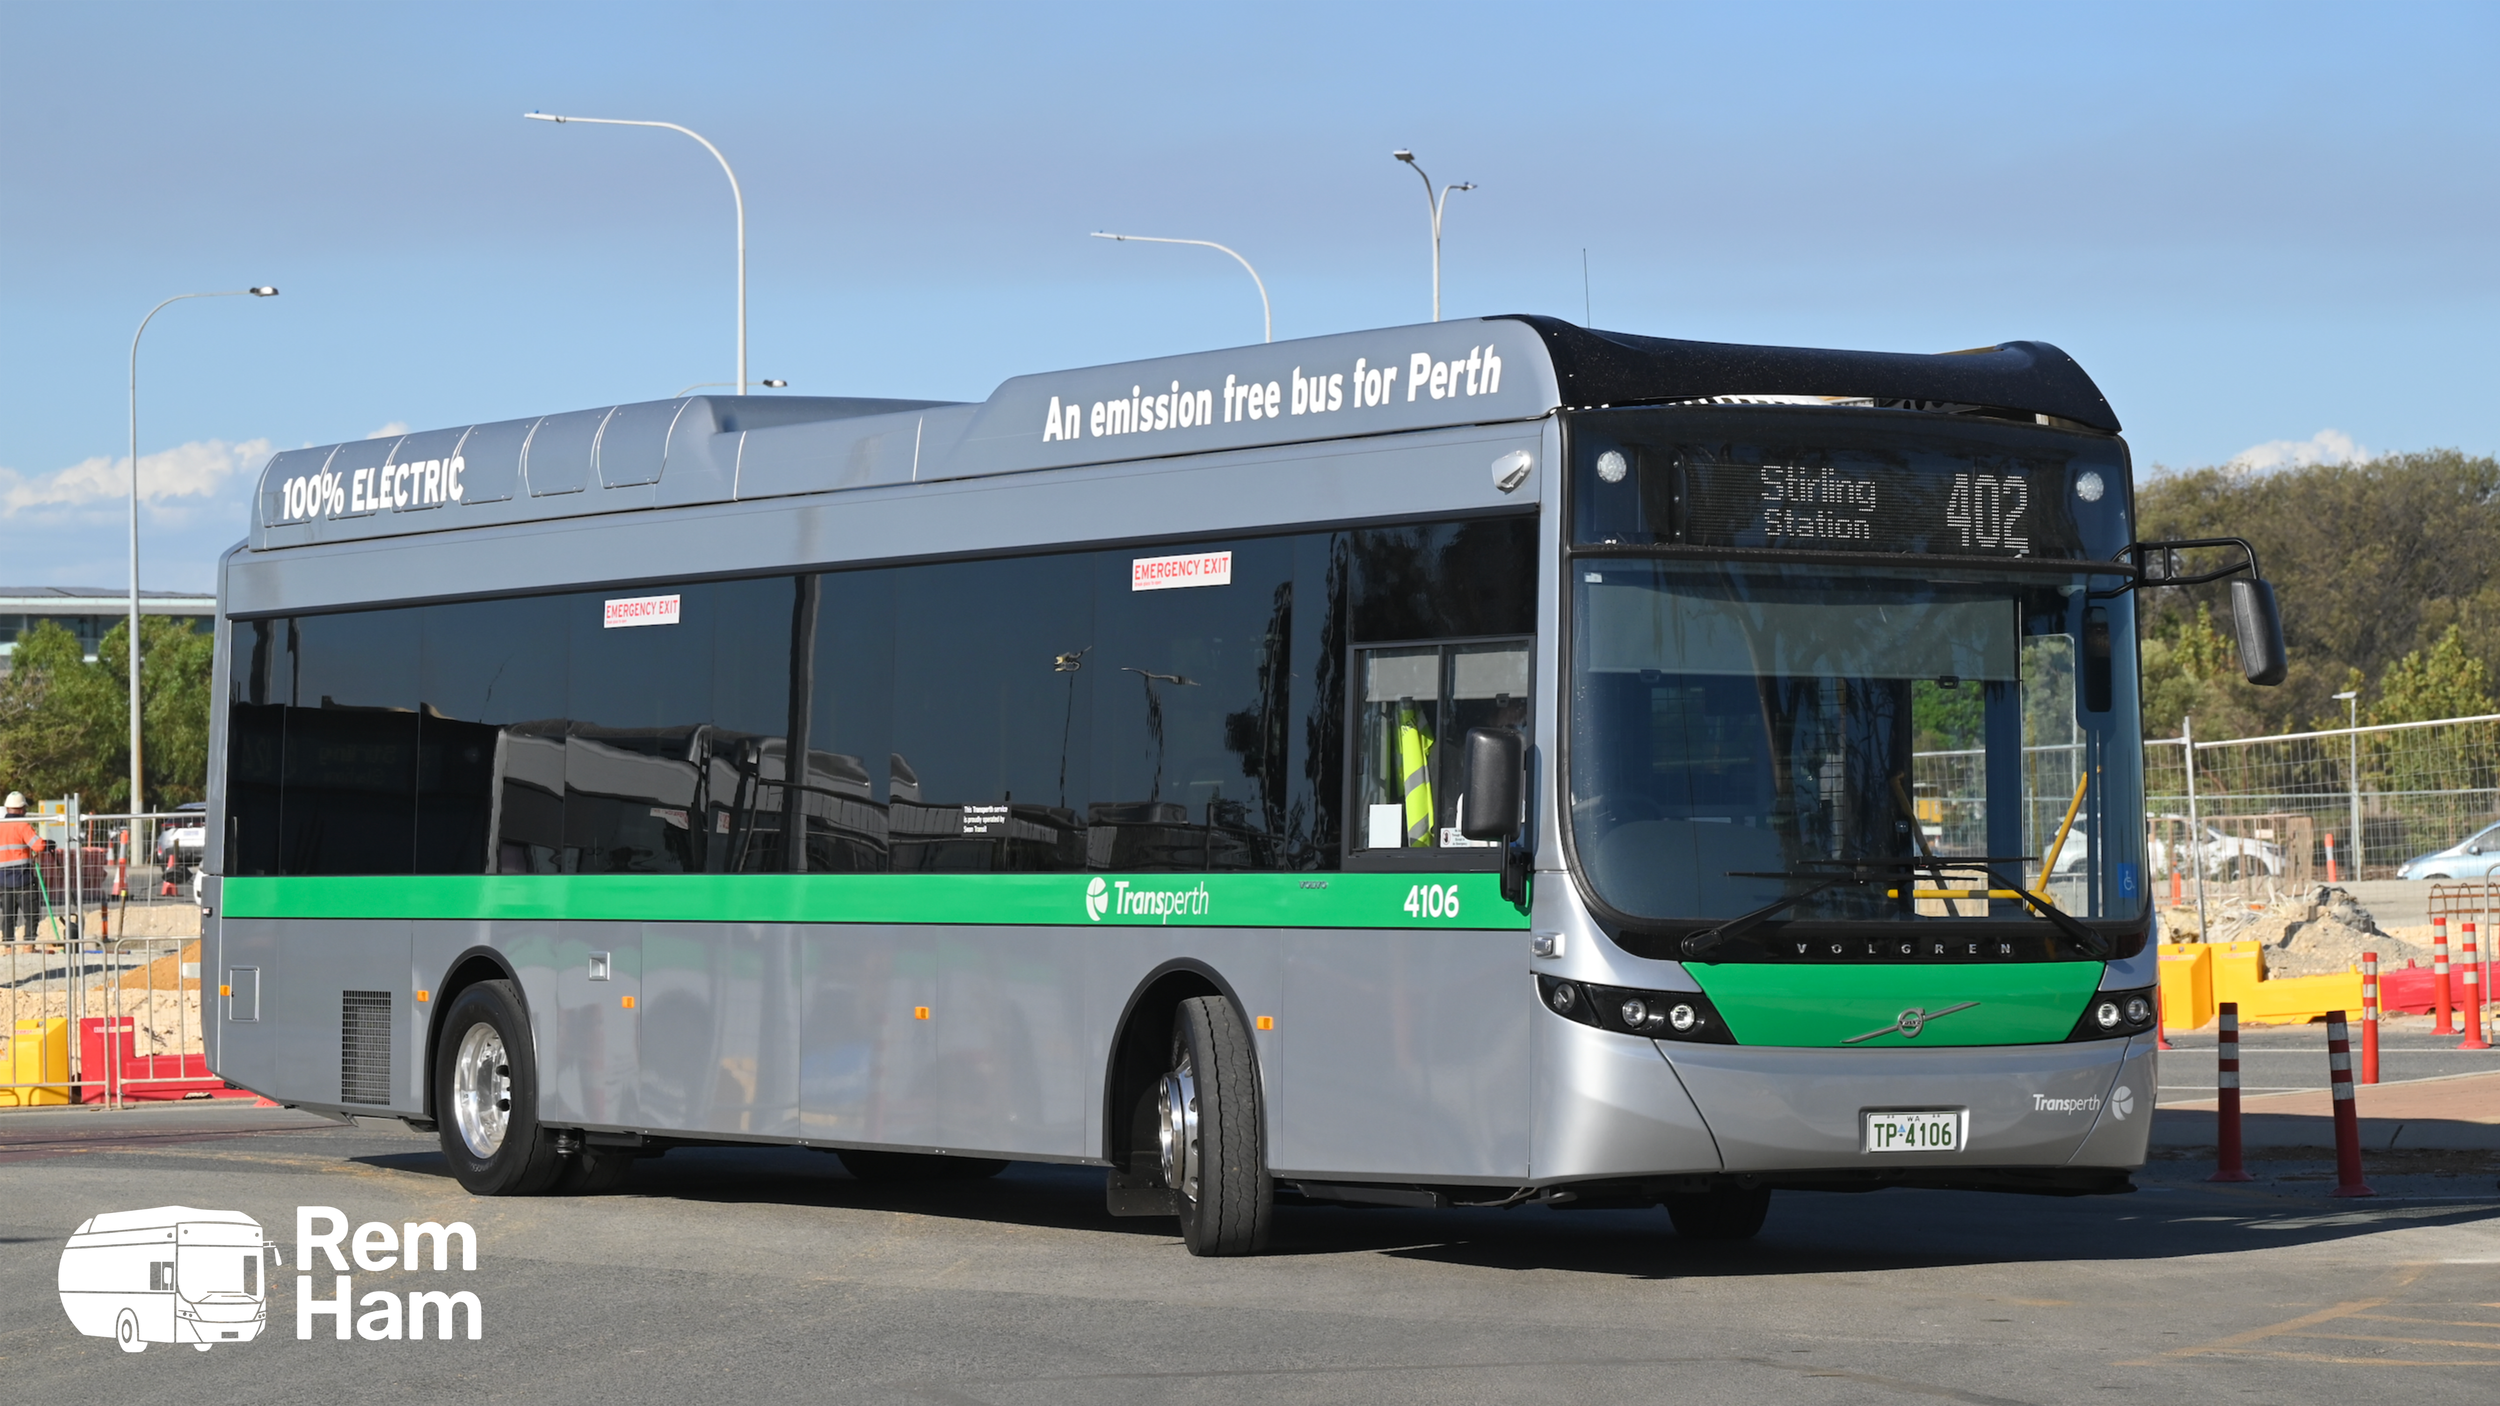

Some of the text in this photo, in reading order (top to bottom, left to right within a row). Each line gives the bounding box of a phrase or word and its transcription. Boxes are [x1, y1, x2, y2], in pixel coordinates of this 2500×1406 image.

[1042, 344, 1502, 442] An emission free bus for Perth
[283, 456, 466, 520] 100% ELECTRIC
[1761, 466, 2029, 549] Stirling 402
[1764, 508, 1870, 538] Station
[1135, 557, 1229, 580] EMERGENCY EXIT
[606, 599, 678, 618] EMERGENCY EXIT
[1114, 881, 1209, 925] Transperth
[1403, 884, 1459, 918] 4106
[1796, 943, 2011, 954] VOLGREN
[2032, 1093, 2100, 1116] Transperth
